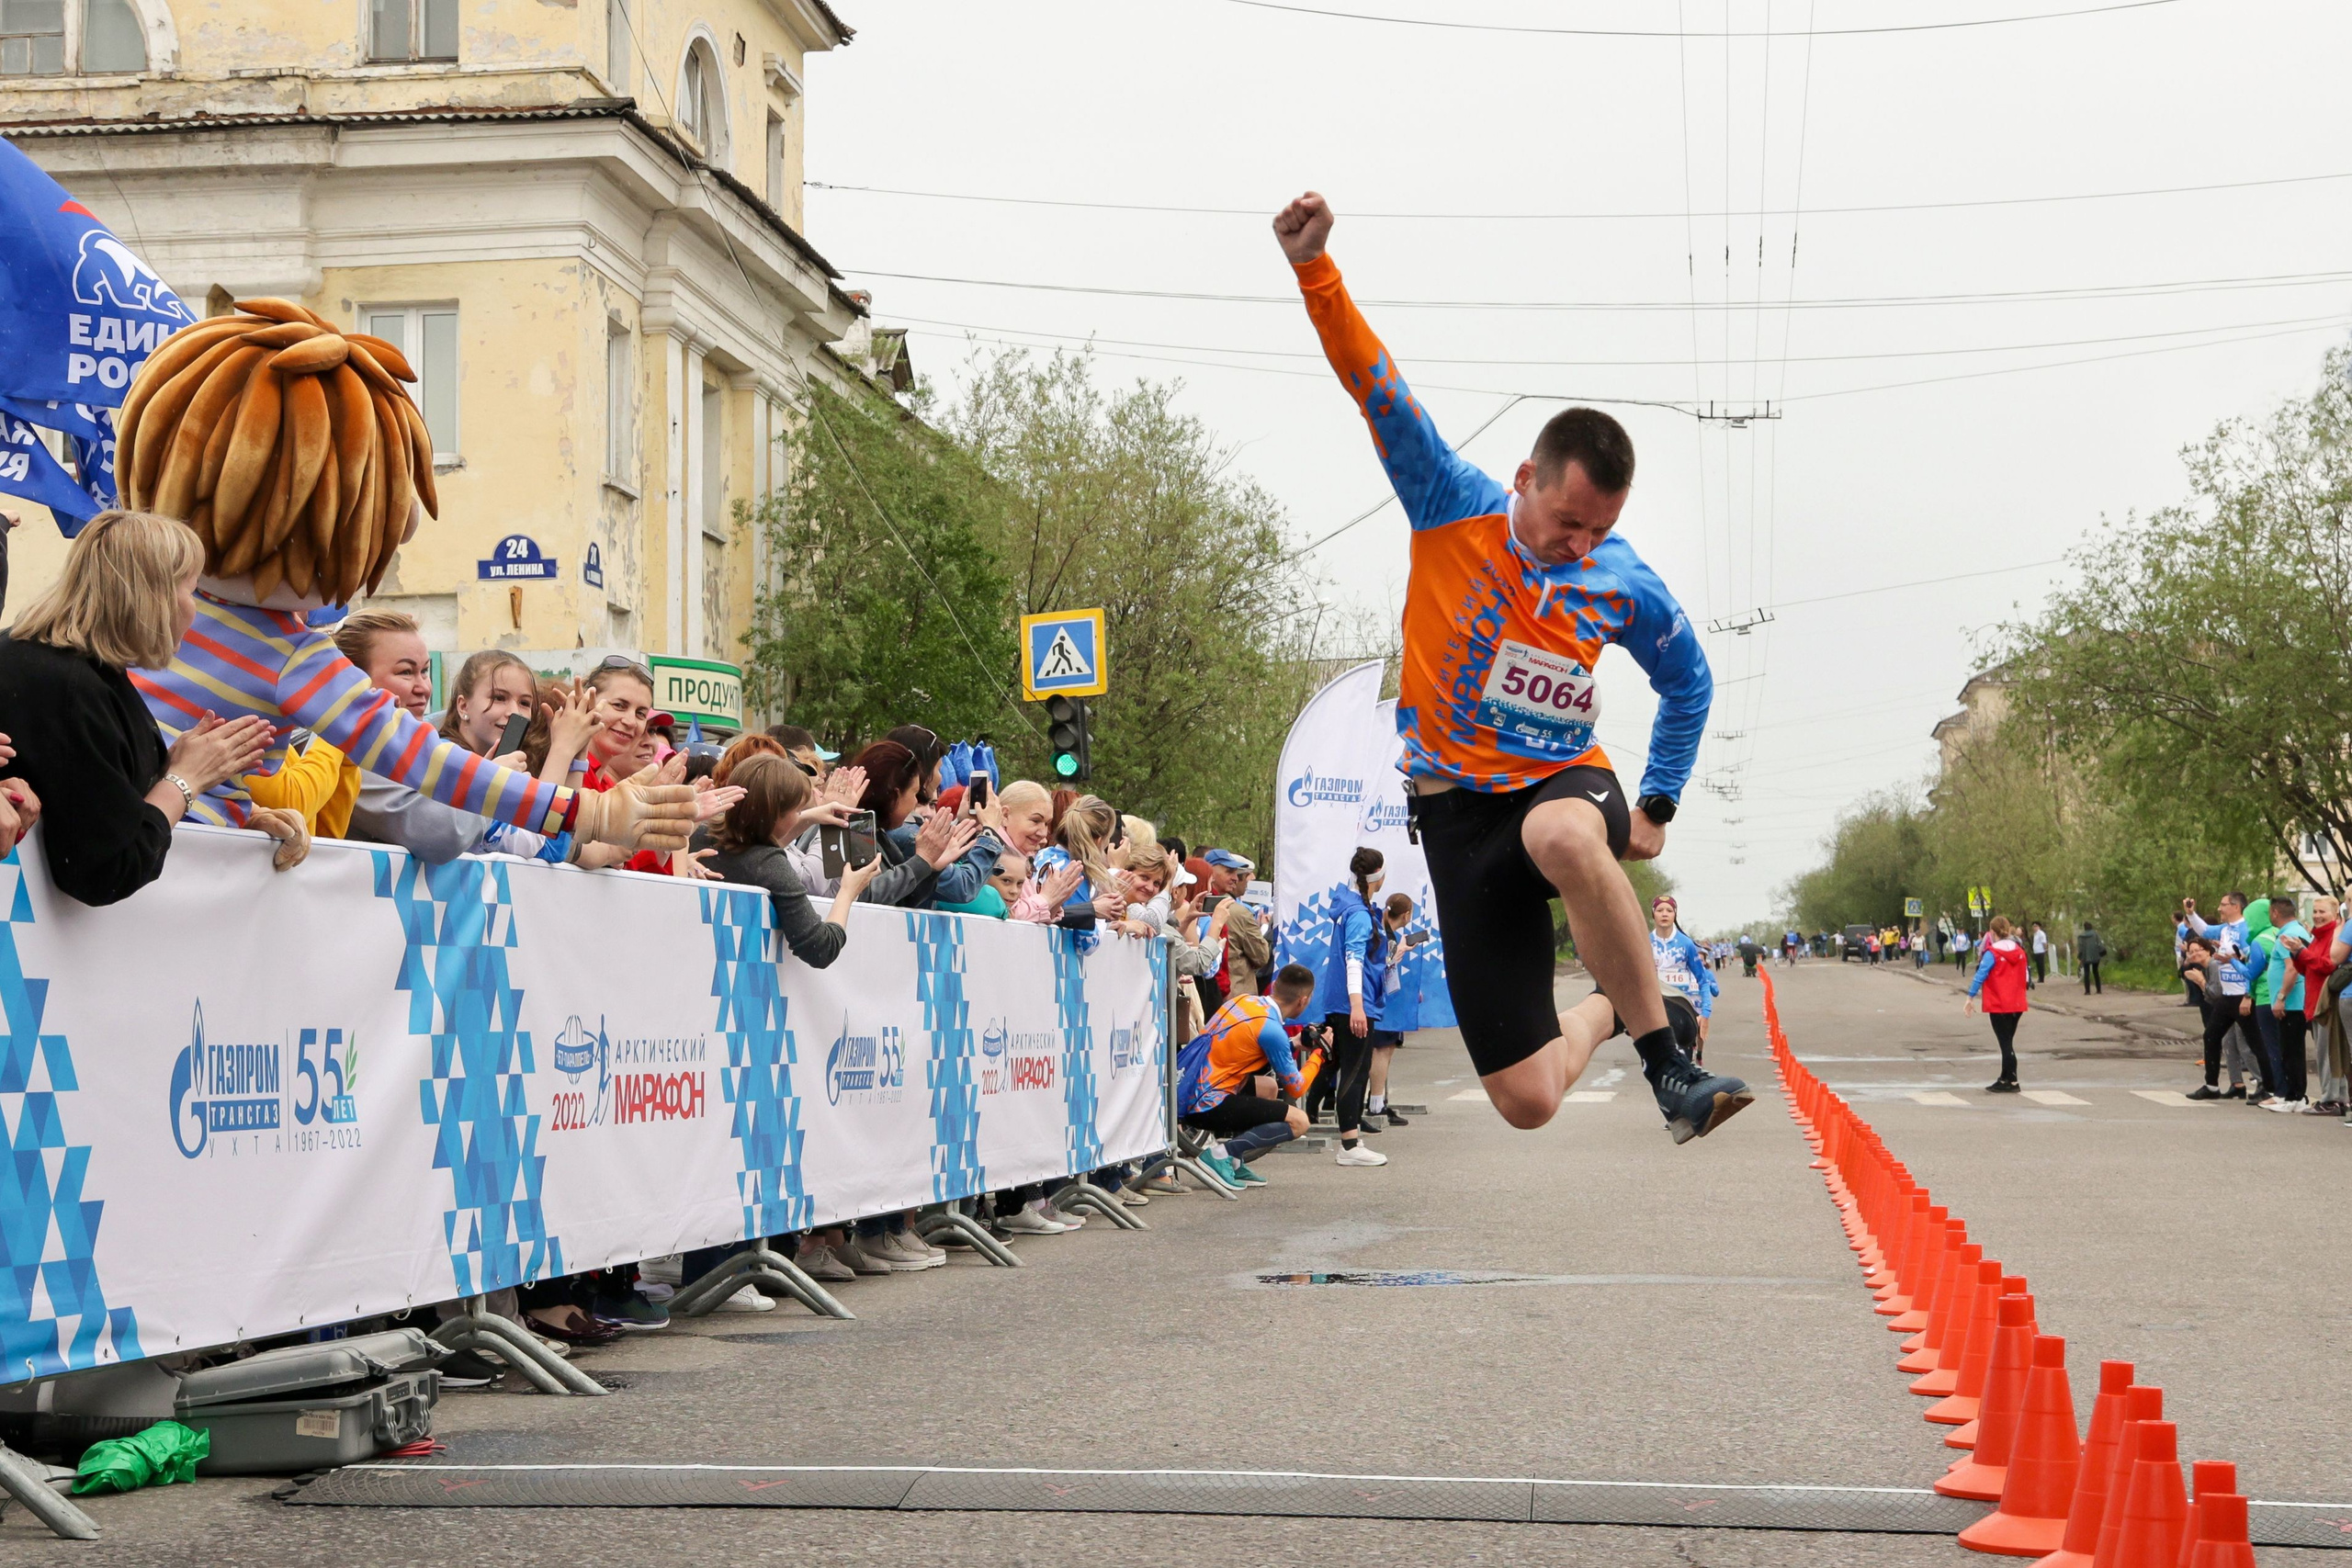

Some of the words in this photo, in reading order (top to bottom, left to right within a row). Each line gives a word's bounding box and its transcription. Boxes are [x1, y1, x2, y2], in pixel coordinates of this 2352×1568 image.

[506, 539, 528, 558] 24
[506, 563, 544, 576] ЛЕНИНА
[1501, 666, 1594, 713] 5064
[1315, 777, 1363, 793] ГАЗПРОМ
[1666, 974, 1684, 982] 116
[615, 1033, 706, 1064] АРКТИЧЕСКИЙ
[844, 1037, 876, 1067] ГАЗПРОМ
[1011, 1029, 1056, 1050] АРКТИЧЕСКИЙ
[208, 1044, 279, 1095] ГАЗПРОМ
[879, 1026, 900, 1088] 55
[295, 1028, 344, 1125] 55
[981, 1069, 998, 1095] 2022
[1011, 1055, 1055, 1091] МАРАФОН
[333, 1099, 355, 1120] ЛЕТ
[551, 1092, 586, 1131] 2022
[615, 1071, 705, 1124] МАРАФОН
[210, 1104, 278, 1127] ТРАНСГАЗ
